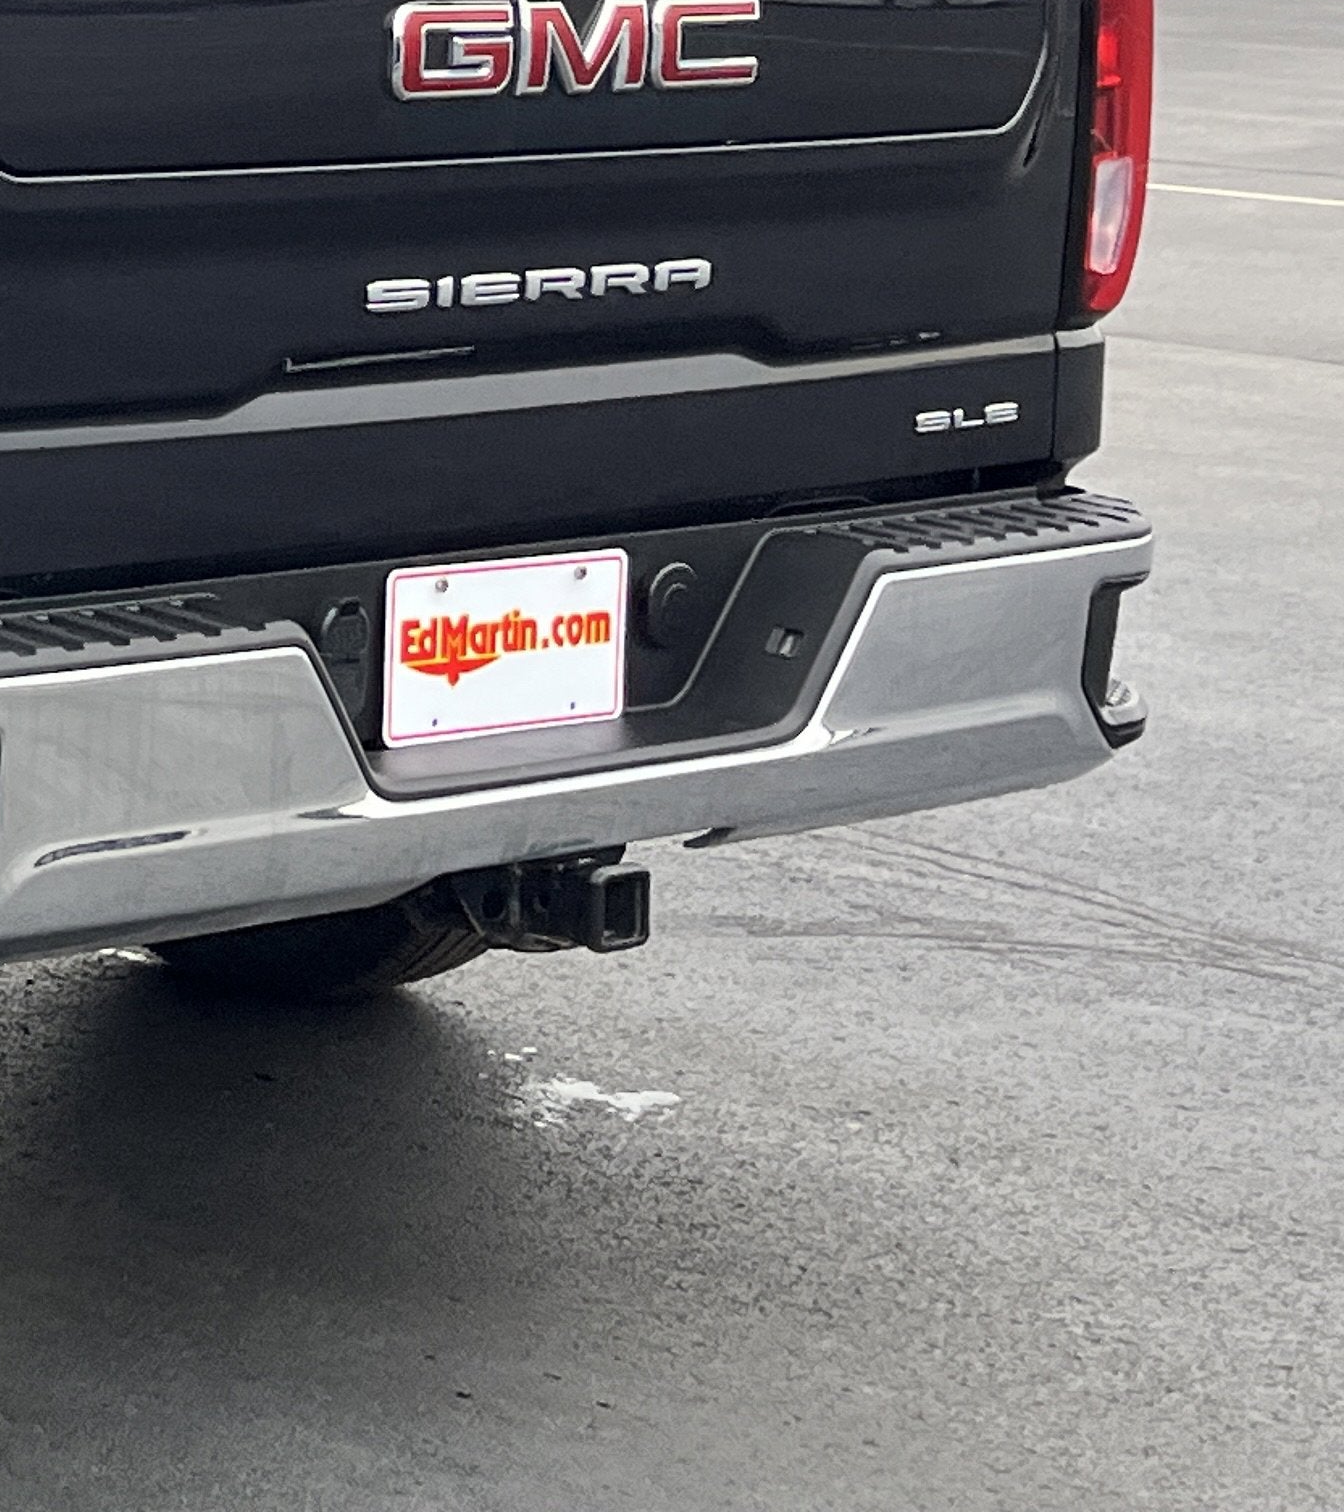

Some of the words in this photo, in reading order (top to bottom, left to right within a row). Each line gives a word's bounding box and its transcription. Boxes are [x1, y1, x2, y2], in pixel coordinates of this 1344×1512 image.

[365, 258, 712, 313] SIERRA
[914, 401, 1020, 434] SLE
[400, 608, 611, 664] EdMartin.com
